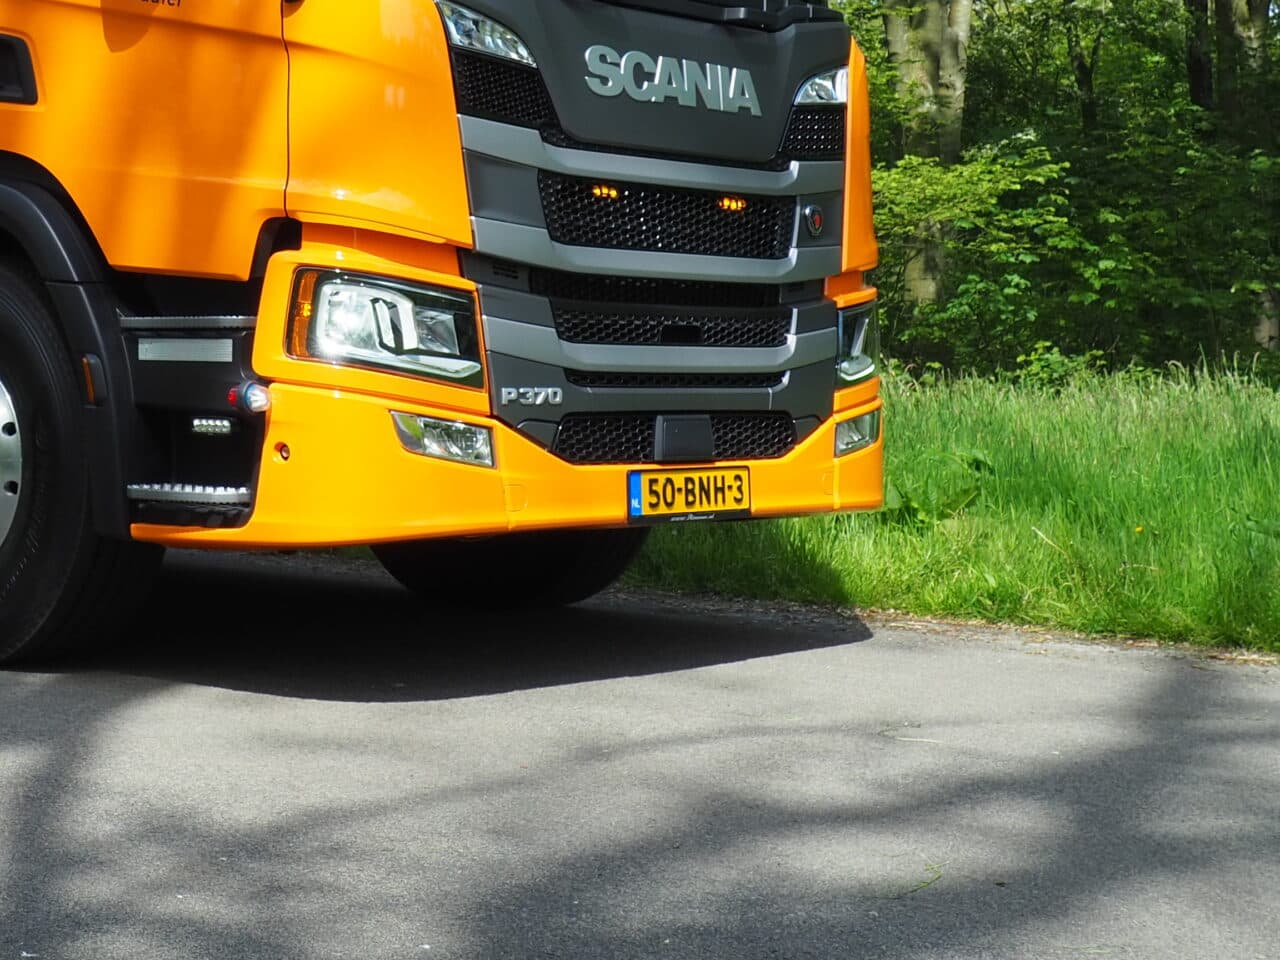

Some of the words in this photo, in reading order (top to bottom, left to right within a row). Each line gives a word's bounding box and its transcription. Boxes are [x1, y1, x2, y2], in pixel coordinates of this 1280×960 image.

[584, 44, 763, 117] SCANIA
[631, 498, 641, 509] NL
[648, 474, 744, 510] 50-BNH-3
